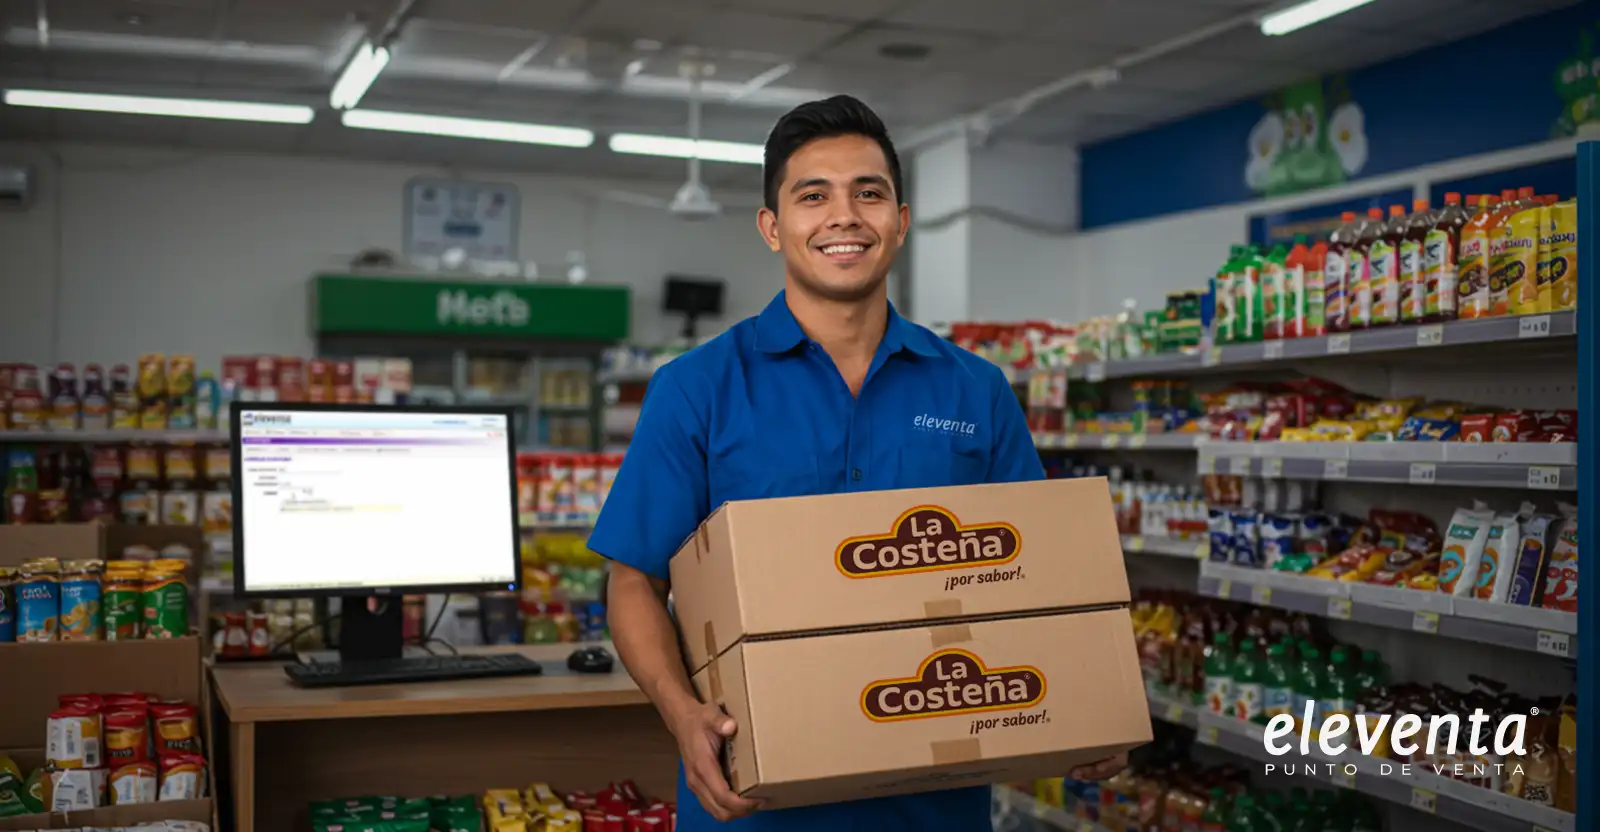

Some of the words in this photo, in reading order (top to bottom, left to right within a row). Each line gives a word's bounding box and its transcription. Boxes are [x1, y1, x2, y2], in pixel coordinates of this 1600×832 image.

[913, 413, 976, 435] eleventa
[910, 516, 942, 538] La
[944, 573, 974, 591] ¡por
[935, 660, 968, 681] La
[969, 716, 1000, 735] ¡por
